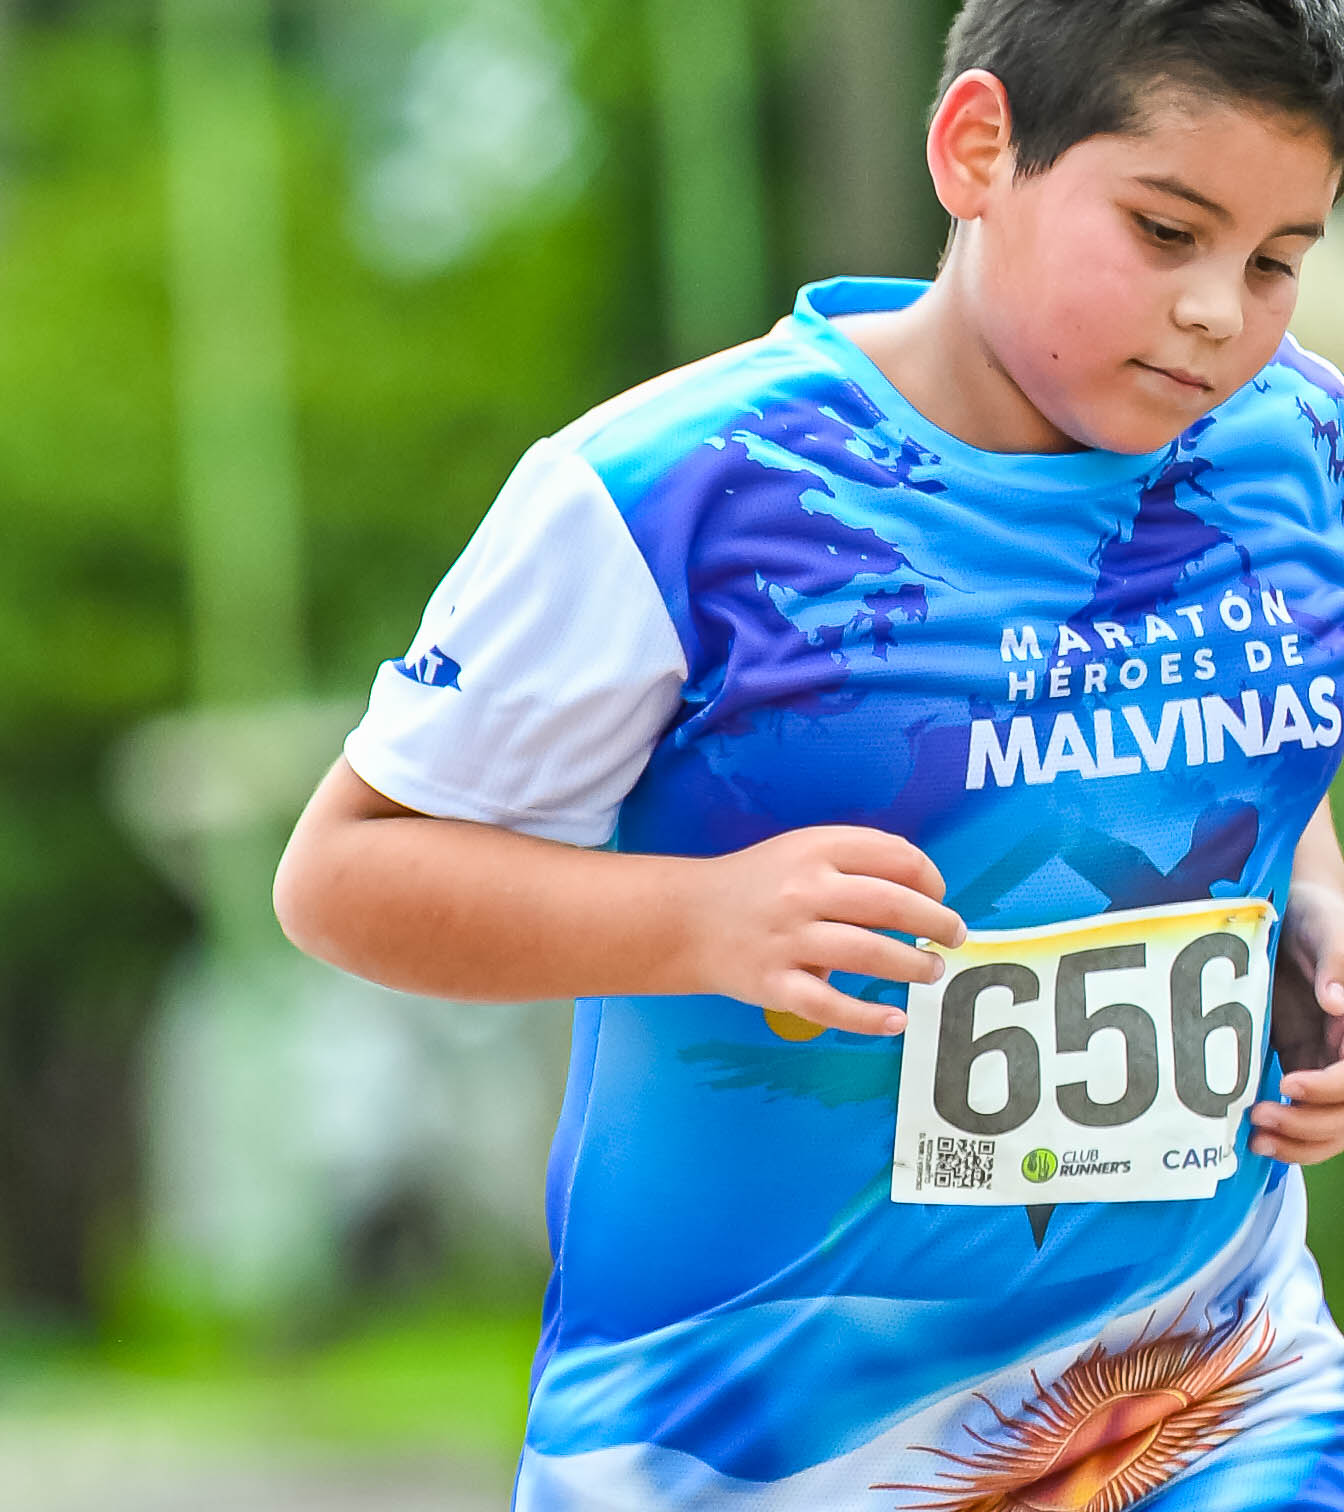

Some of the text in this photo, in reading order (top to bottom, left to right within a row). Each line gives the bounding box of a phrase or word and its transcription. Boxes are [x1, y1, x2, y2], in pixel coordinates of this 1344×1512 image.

[999, 589, 1294, 663] MARATÓN
[1007, 633, 1305, 701] HÉROES DE
[965, 676, 1343, 791] MALVINAS
[933, 931, 1254, 1136] 656
[1059, 1160, 1131, 1177] RUNNER'S
[1062, 1149, 1099, 1164] CLUB
